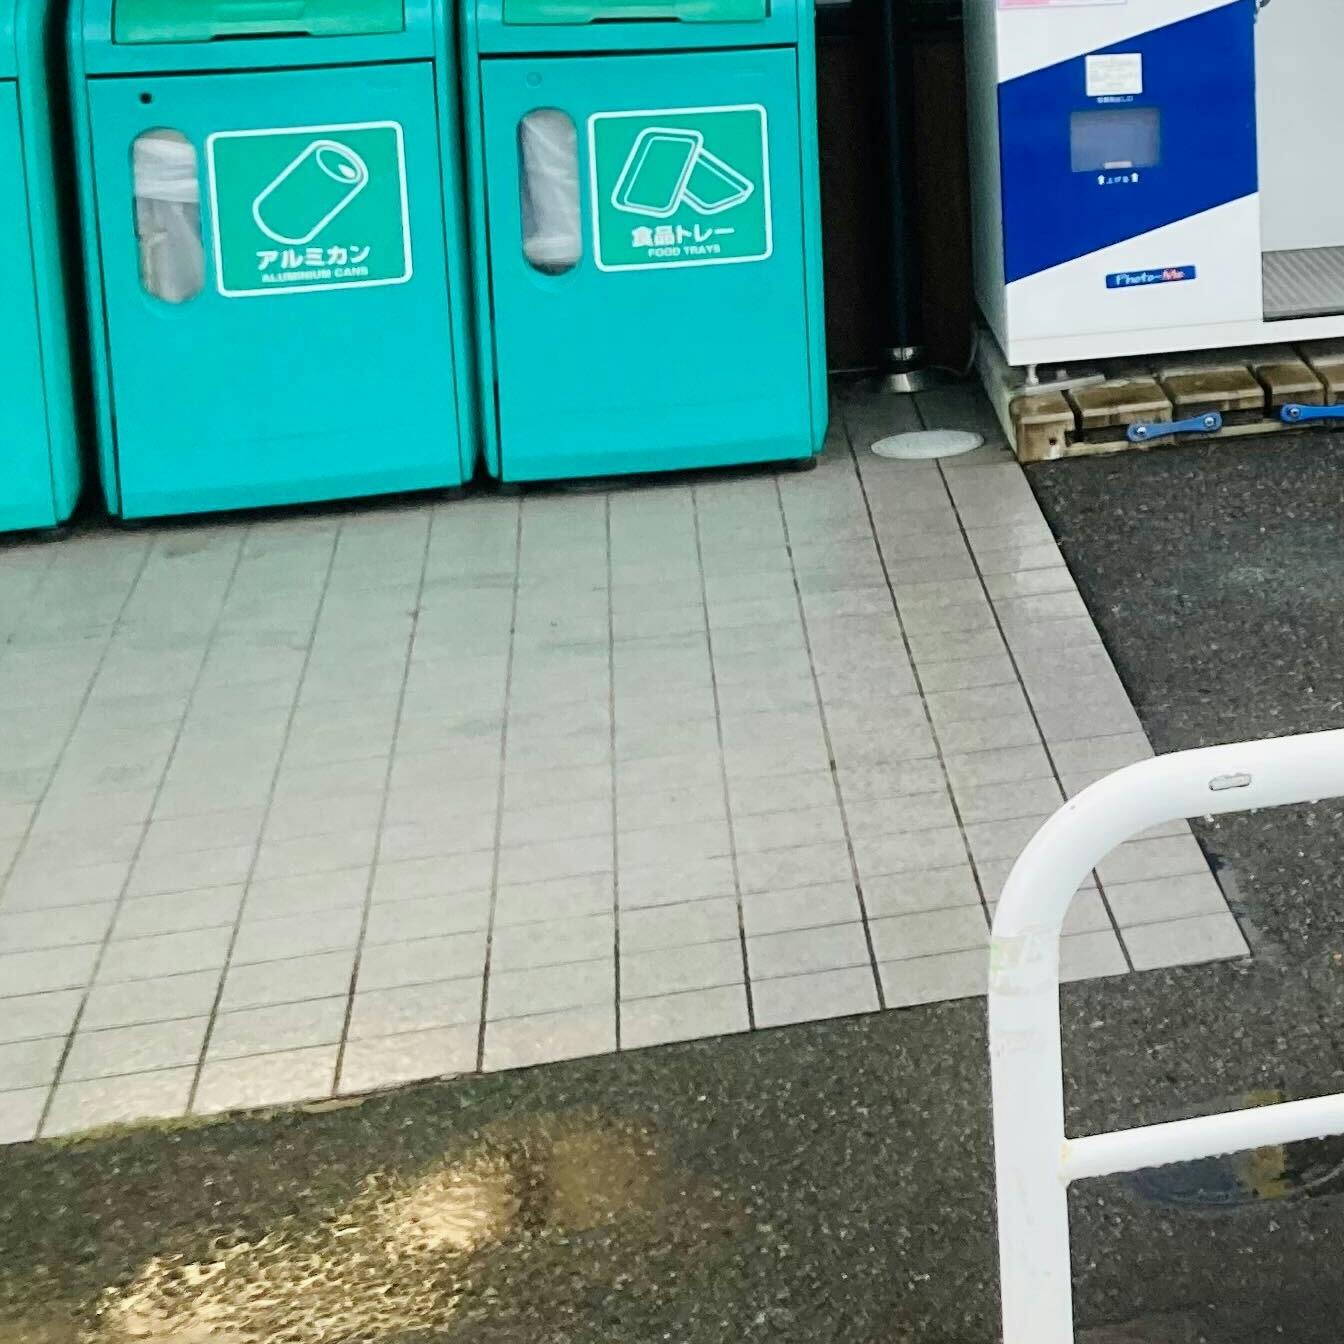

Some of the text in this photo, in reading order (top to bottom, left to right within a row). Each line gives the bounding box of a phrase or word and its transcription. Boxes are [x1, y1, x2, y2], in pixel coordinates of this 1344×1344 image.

[632, 223, 736, 248] 食品トレー
[255, 244, 371, 271] アルミカン
[648, 244, 720, 258] FOOD TRAYS
[261, 265, 369, 284] ALUMINIUM CANS
